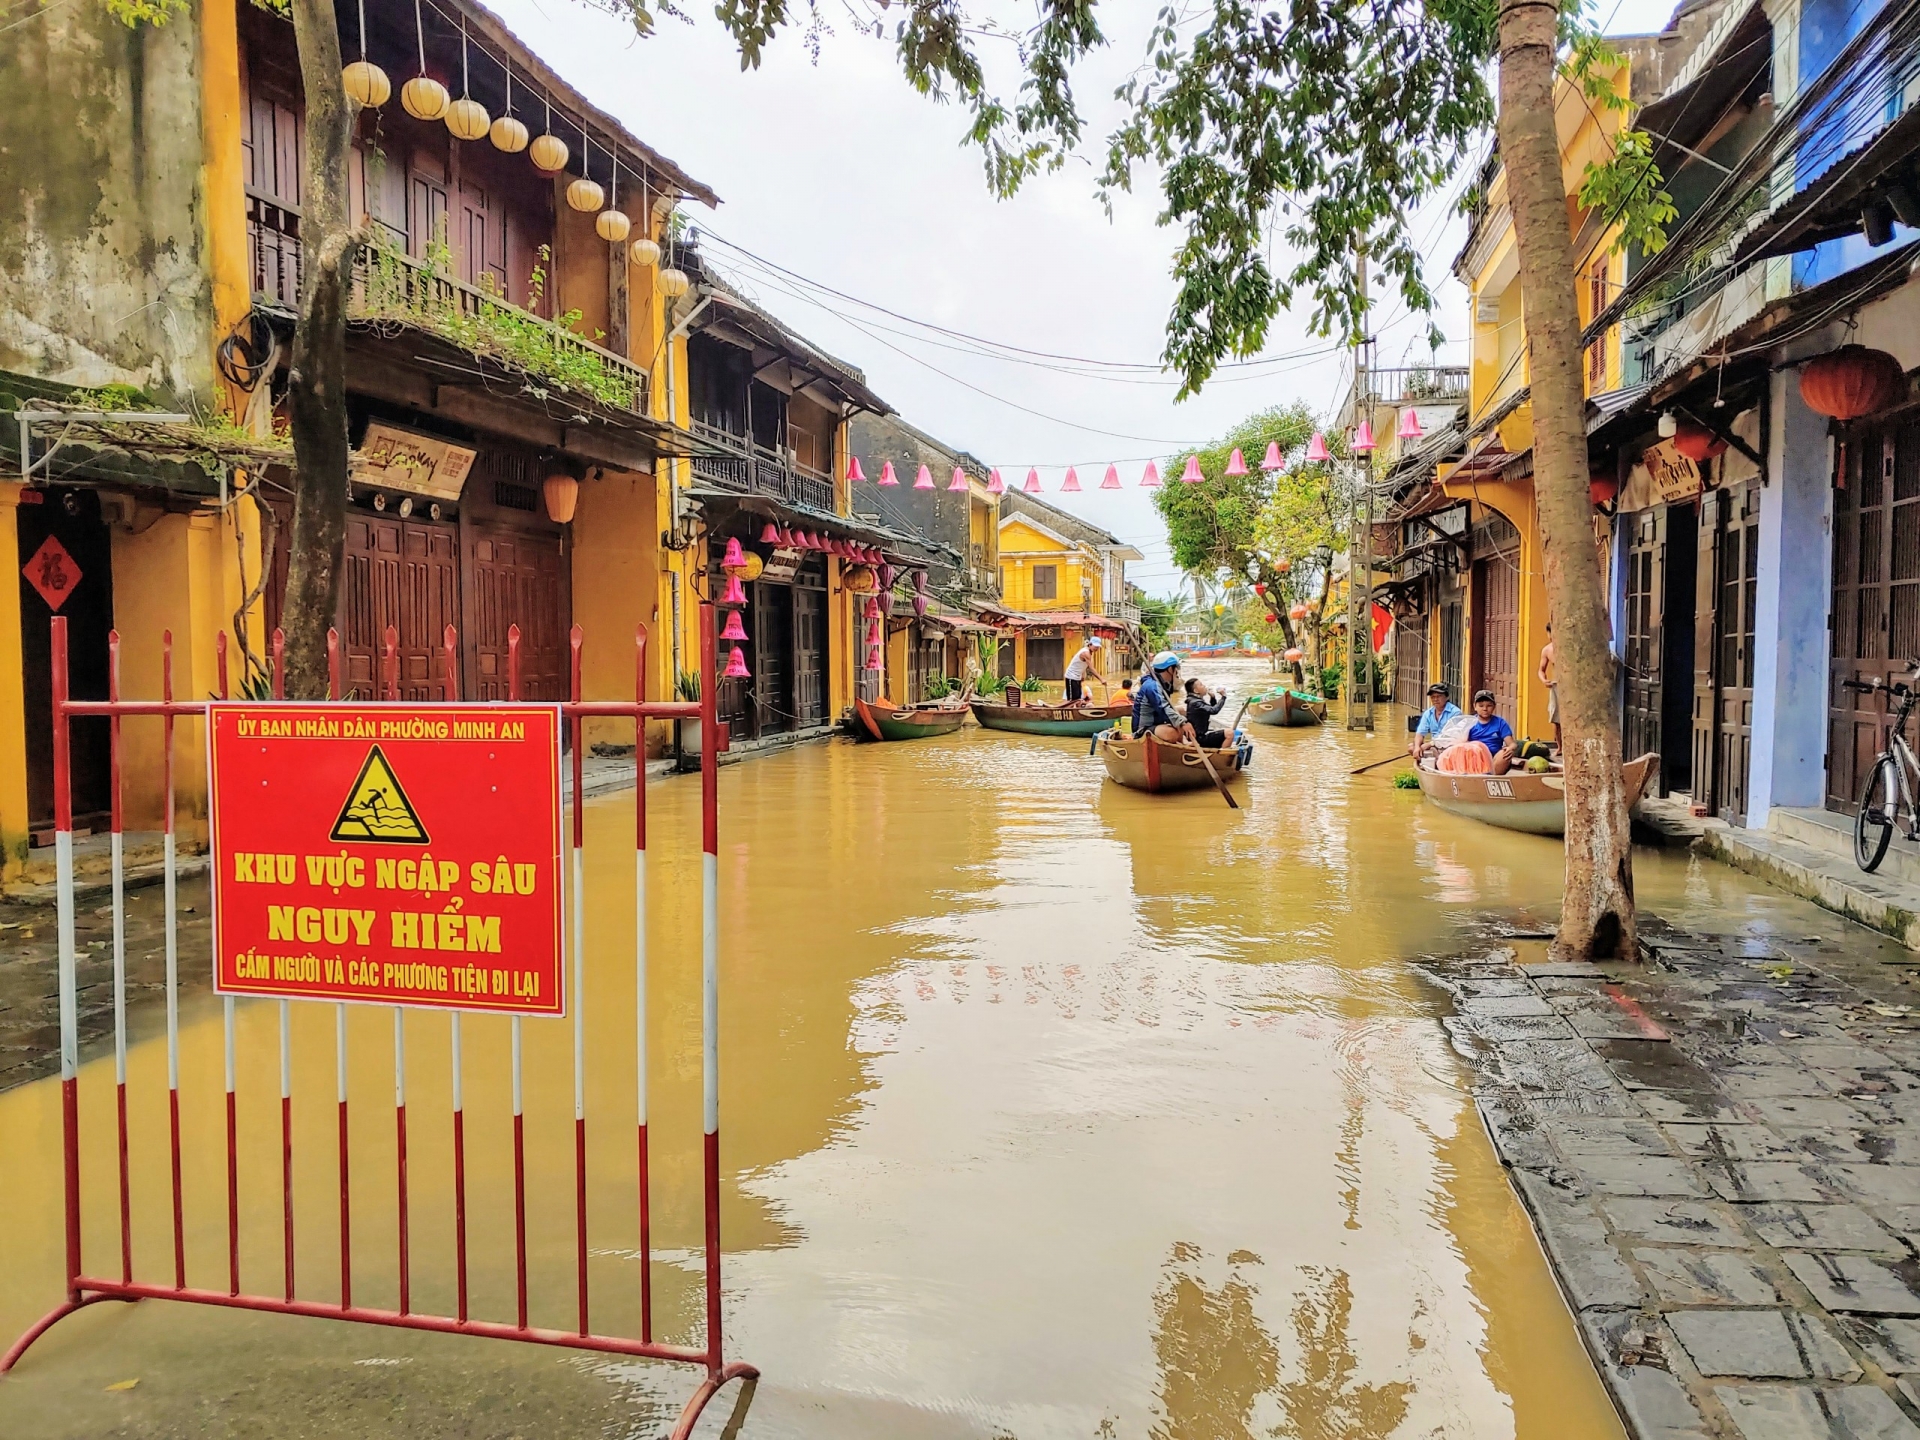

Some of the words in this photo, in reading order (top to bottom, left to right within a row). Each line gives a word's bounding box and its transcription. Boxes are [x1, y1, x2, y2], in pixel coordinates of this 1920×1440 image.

[238, 714, 256, 736] ỦY
[261, 720, 291, 736] BAN
[296, 717, 339, 736] NHÂN
[343, 717, 375, 737] DÂN
[381, 717, 448, 738] PHƯỜNG
[454, 722, 496, 738] MINH
[501, 722, 525, 739] AN
[235, 852, 296, 884] KHU
[306, 850, 365, 894] VỰC
[376, 853, 459, 898] NGẬP
[471, 855, 536, 895] SÂU
[268, 905, 375, 945] NGUY
[391, 897, 501, 953] HIỂM
[236, 947, 270, 979] CẤM
[274, 953, 320, 982] NGƯỜI
[324, 958, 344, 983] VÀ
[349, 957, 379, 986] CÁC
[384, 963, 448, 991] PHƯƠNG
[452, 963, 487, 998] TIỆN
[492, 971, 509, 996] ĐI
[514, 971, 539, 1001] LẠI
